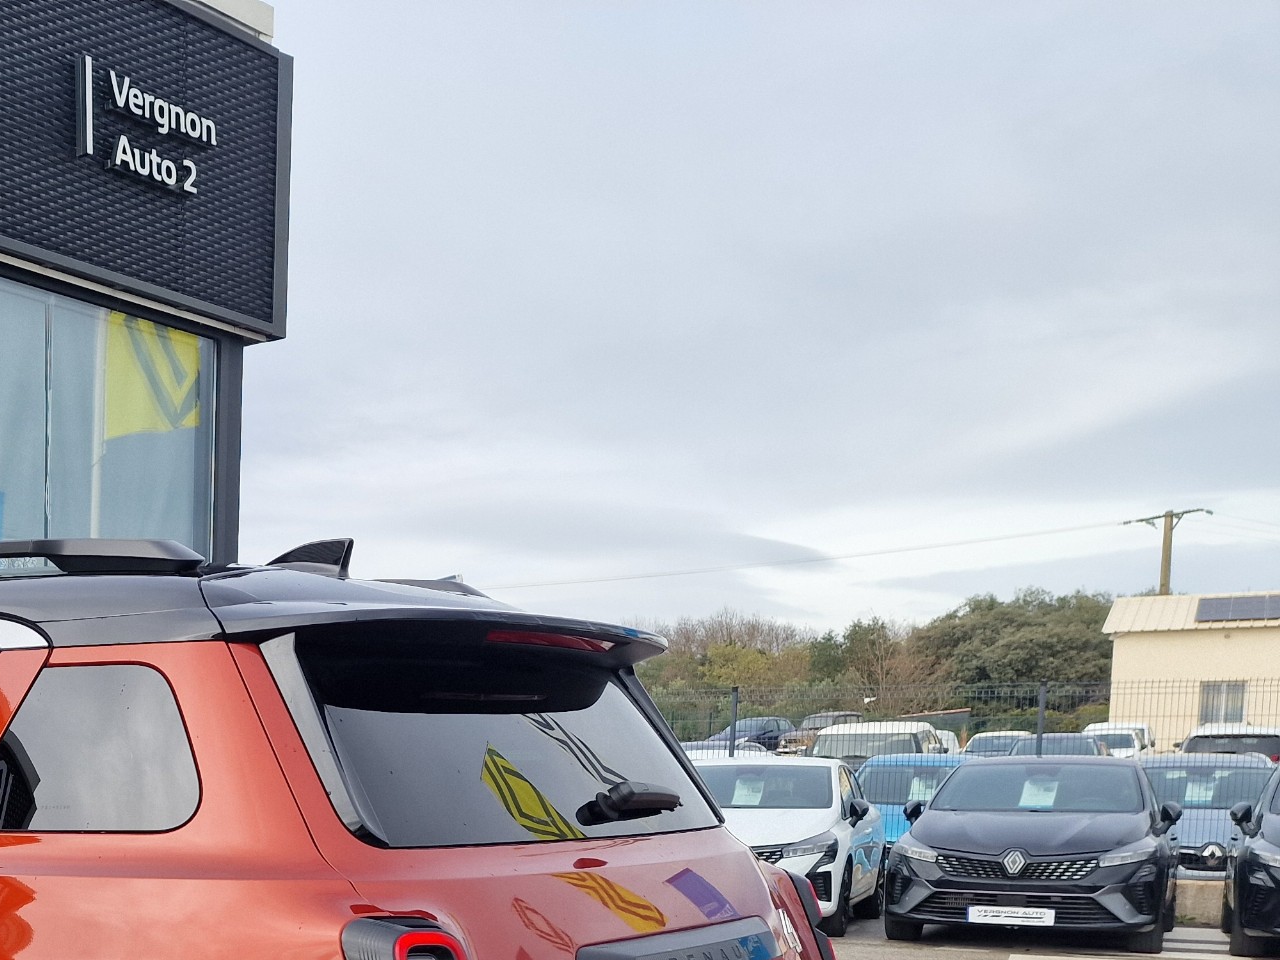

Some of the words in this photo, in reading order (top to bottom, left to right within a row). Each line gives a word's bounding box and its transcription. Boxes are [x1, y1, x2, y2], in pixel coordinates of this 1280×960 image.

[109, 69, 218, 146] Vergnon
[115, 134, 177, 185] Auto
[182, 159, 198, 194] 2
